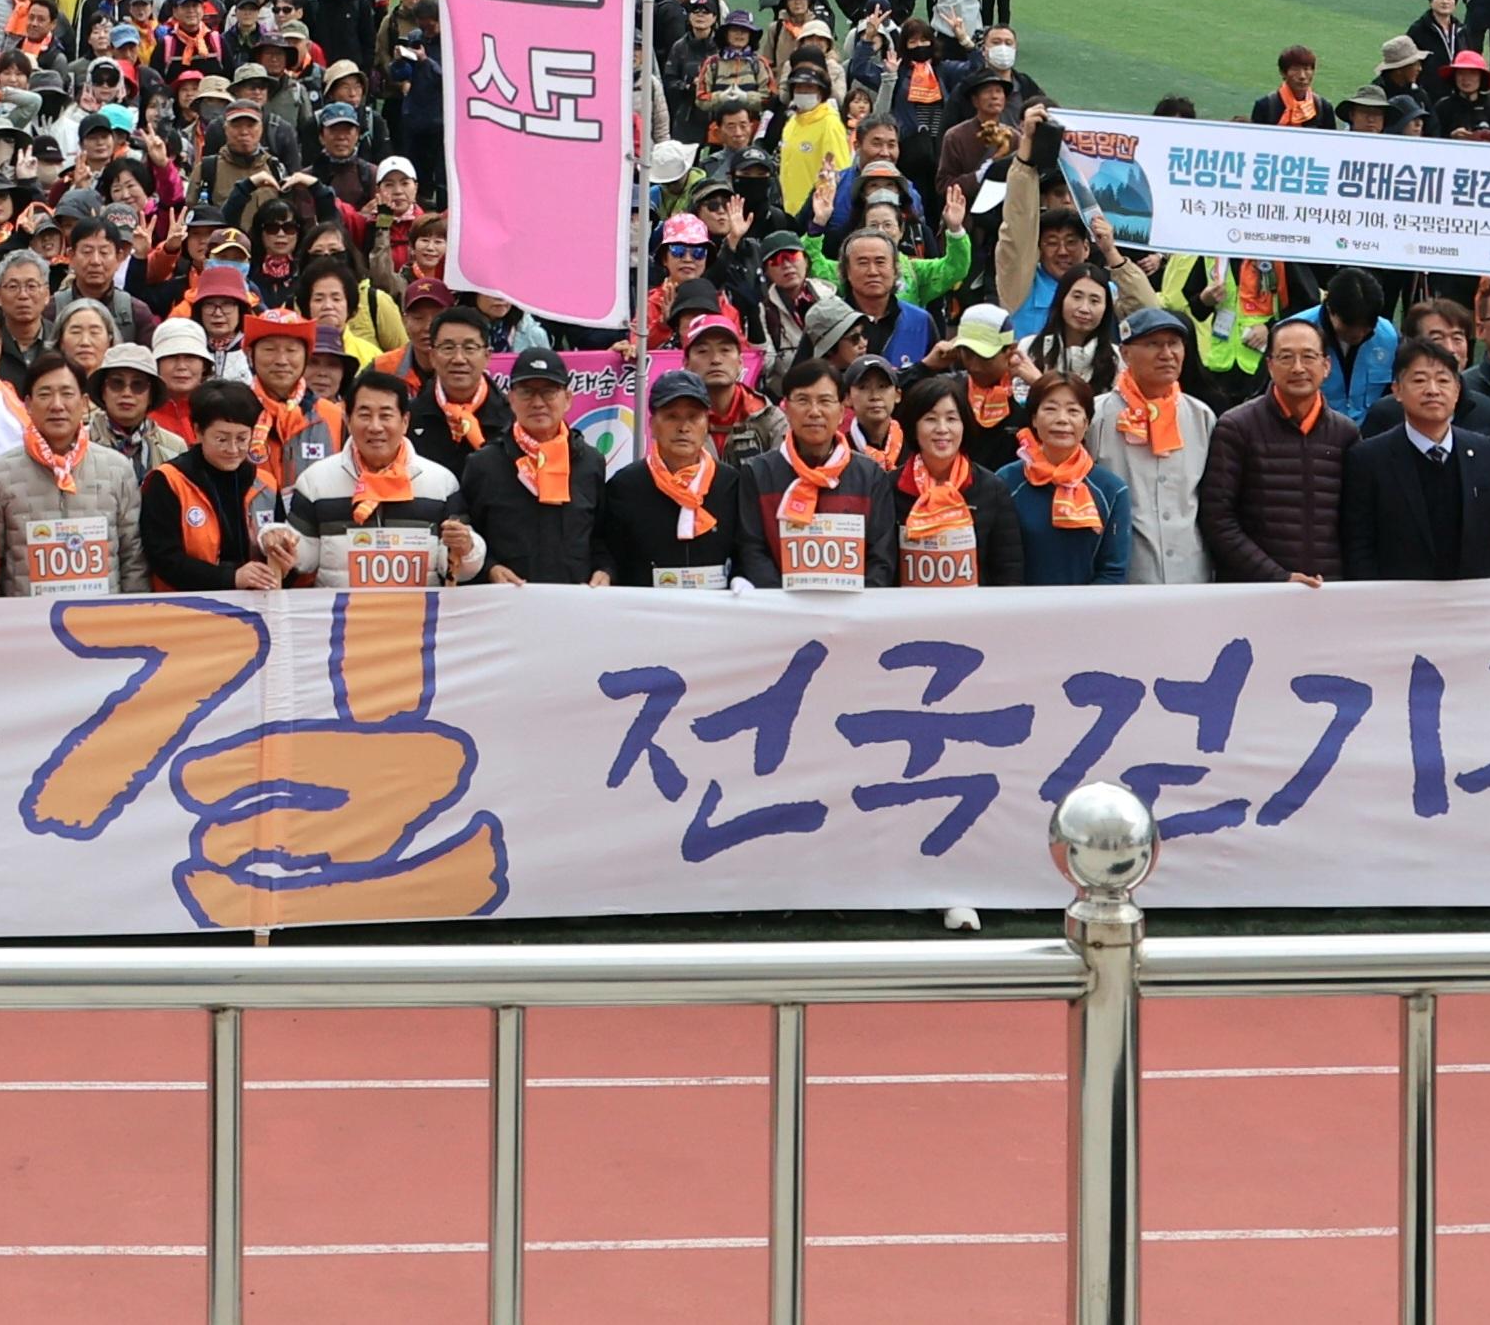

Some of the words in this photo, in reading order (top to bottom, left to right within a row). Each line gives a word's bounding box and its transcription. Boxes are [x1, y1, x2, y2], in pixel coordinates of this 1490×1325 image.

[1168, 146, 1245, 189] 천성산
[1250, 152, 1330, 196] 화엄늪
[1337, 159, 1445, 205] 생태습지
[1180, 198, 1208, 217] 지속
[1211, 200, 1252, 220] 가능한
[1293, 206, 1352, 227] 지역사회
[34, 544, 104, 578] 1003
[356, 554, 422, 584] 1001
[787, 539, 859, 569] 1005
[904, 554, 974, 583] 1004
[19, 592, 513, 930] 길
